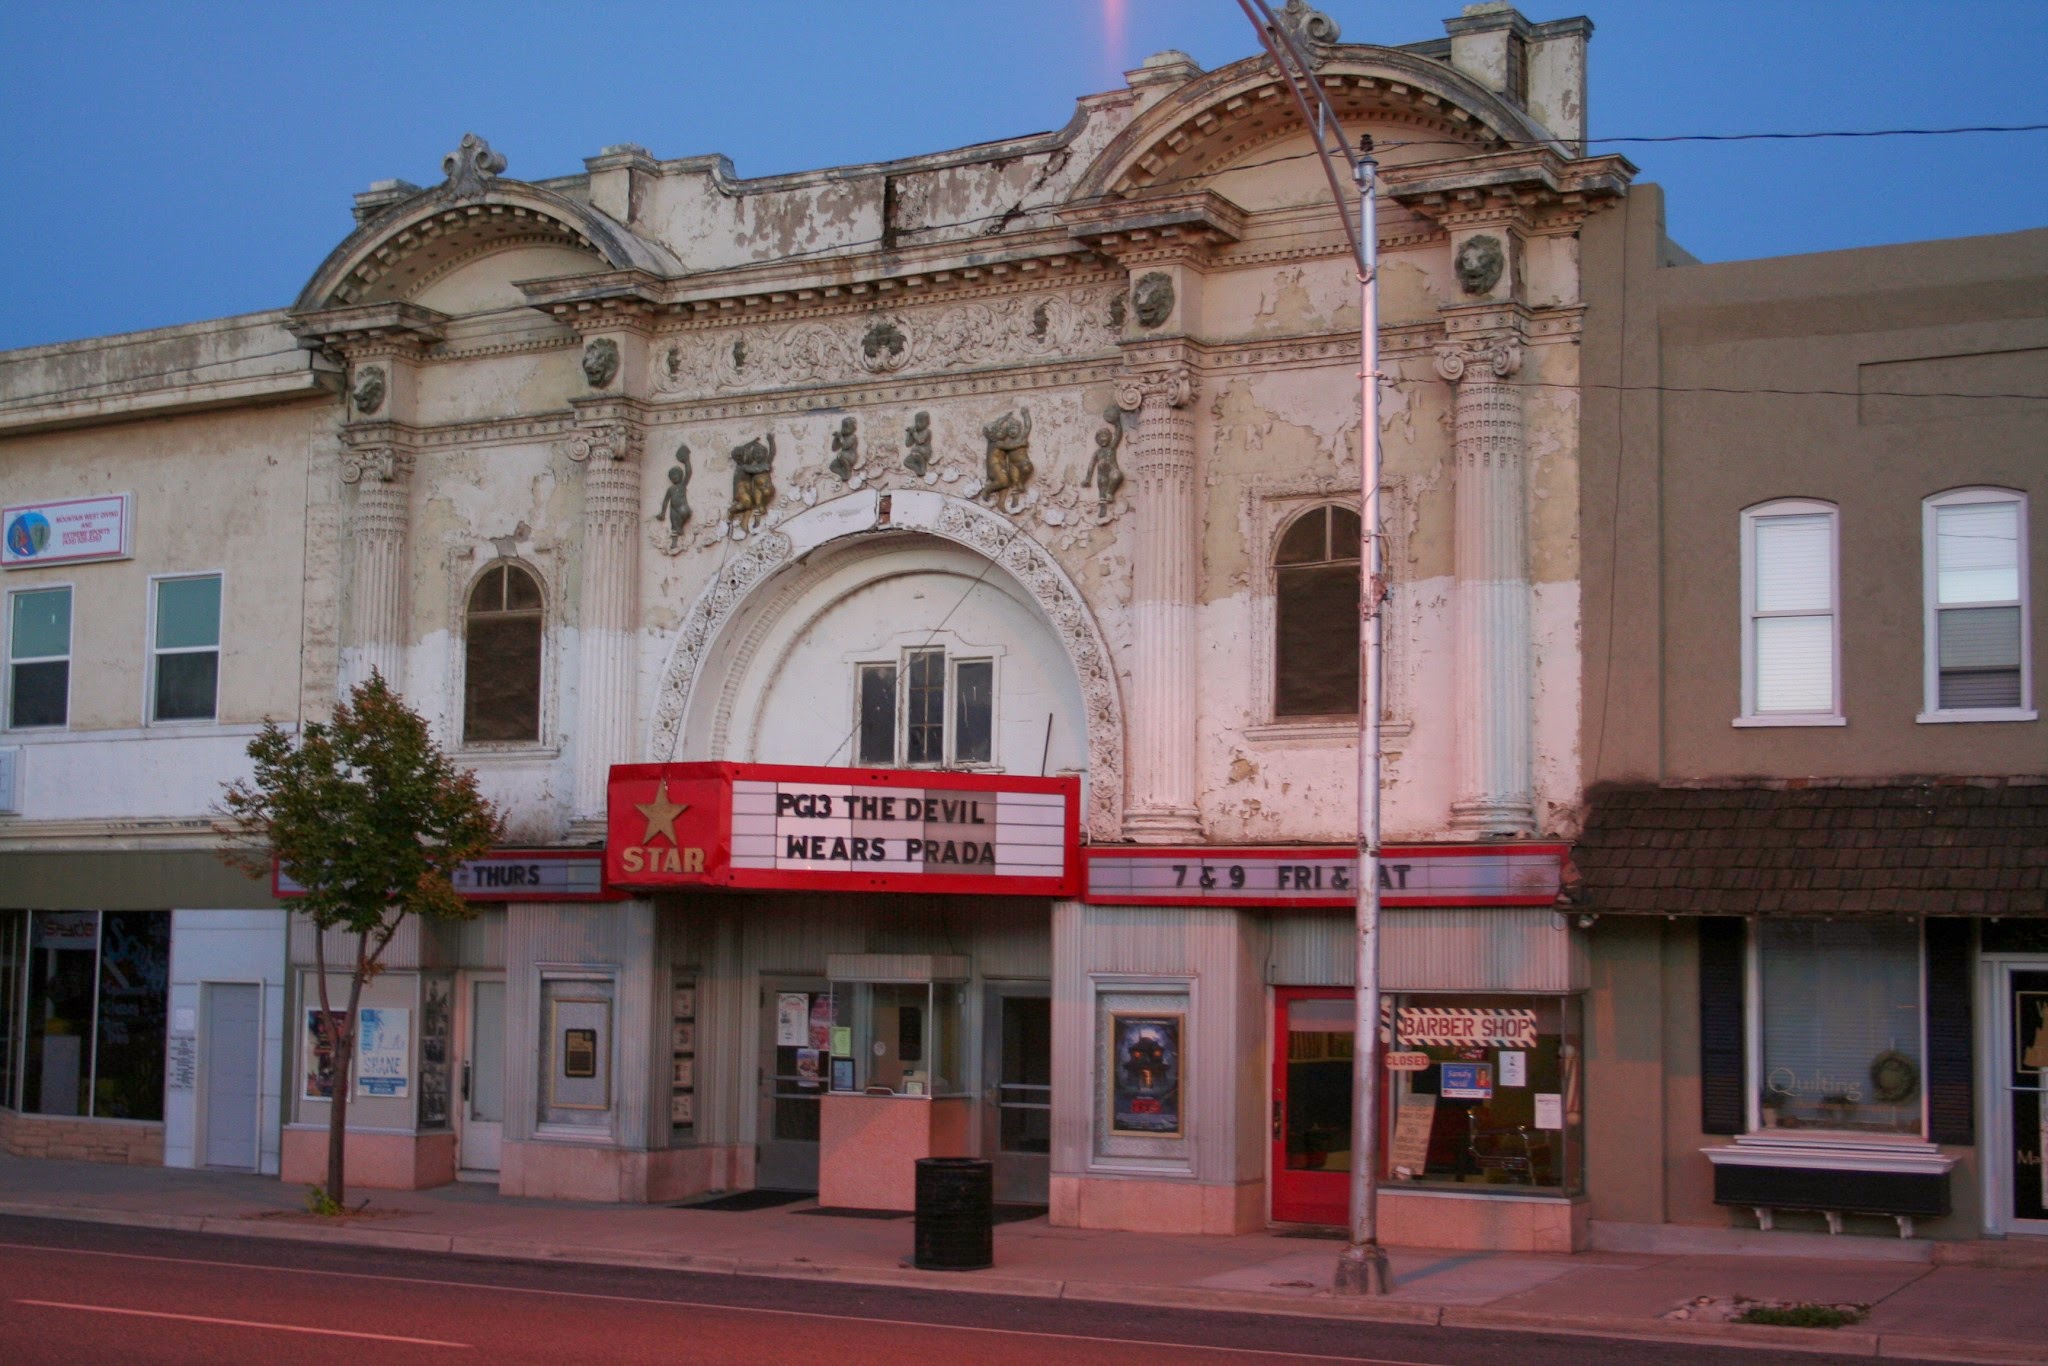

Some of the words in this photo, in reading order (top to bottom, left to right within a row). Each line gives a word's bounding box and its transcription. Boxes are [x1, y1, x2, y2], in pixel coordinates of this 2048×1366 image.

[56, 514, 83, 523] MOUNTAIN
[84, 512, 99, 520] WEST
[100, 510, 119, 519] DIVING
[776, 792, 832, 819] PG13
[843, 795, 896, 820] THE
[905, 797, 985, 825] DEVIL
[622, 846, 705, 873] STAR
[786, 834, 887, 862] WEARS
[906, 837, 997, 866] PRADA
[473, 864, 540, 887] THURS
[1172, 864, 1188, 888] 7
[1198, 865, 1217, 890] &
[1228, 864, 1245, 889] 9
[1277, 865, 1322, 890] FRI
[1331, 865, 1349, 890] &
[1378, 864, 1411, 890] AT
[1403, 1016, 1475, 1037] BARBER
[1481, 1018, 1530, 1038] SHOP
[1385, 1053, 1428, 1067] CLOSED
[1768, 1067, 1863, 1101] Quilting
